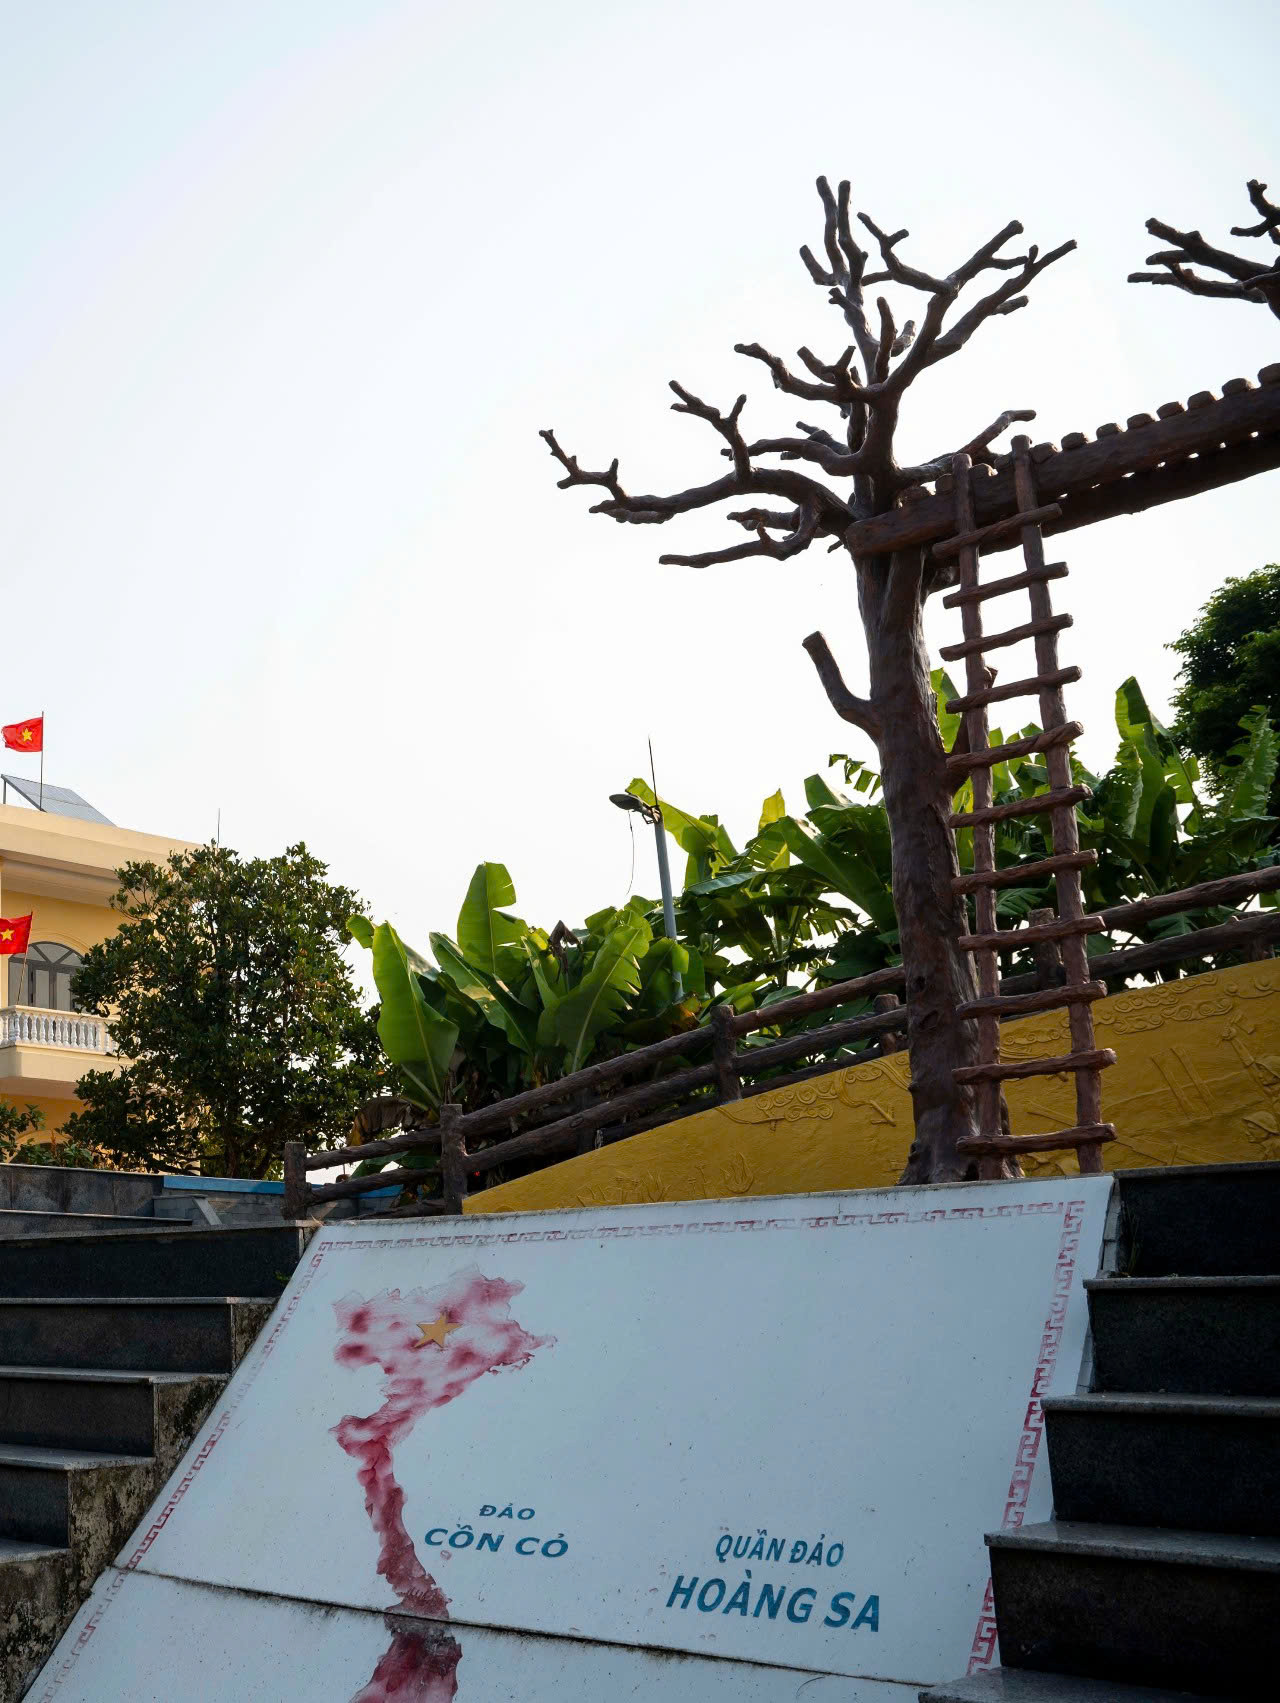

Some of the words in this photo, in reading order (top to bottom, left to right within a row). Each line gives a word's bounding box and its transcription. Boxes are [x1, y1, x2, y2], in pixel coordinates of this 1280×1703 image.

[479, 1502, 536, 1520] ĐẢO
[424, 1523, 505, 1553] CỒN
[515, 1533, 569, 1558] CỎ
[715, 1529, 786, 1563] QUẦN
[789, 1533, 844, 1567] ĐẢO
[665, 1568, 814, 1625] HOÀNG
[824, 1591, 880, 1633] SA
